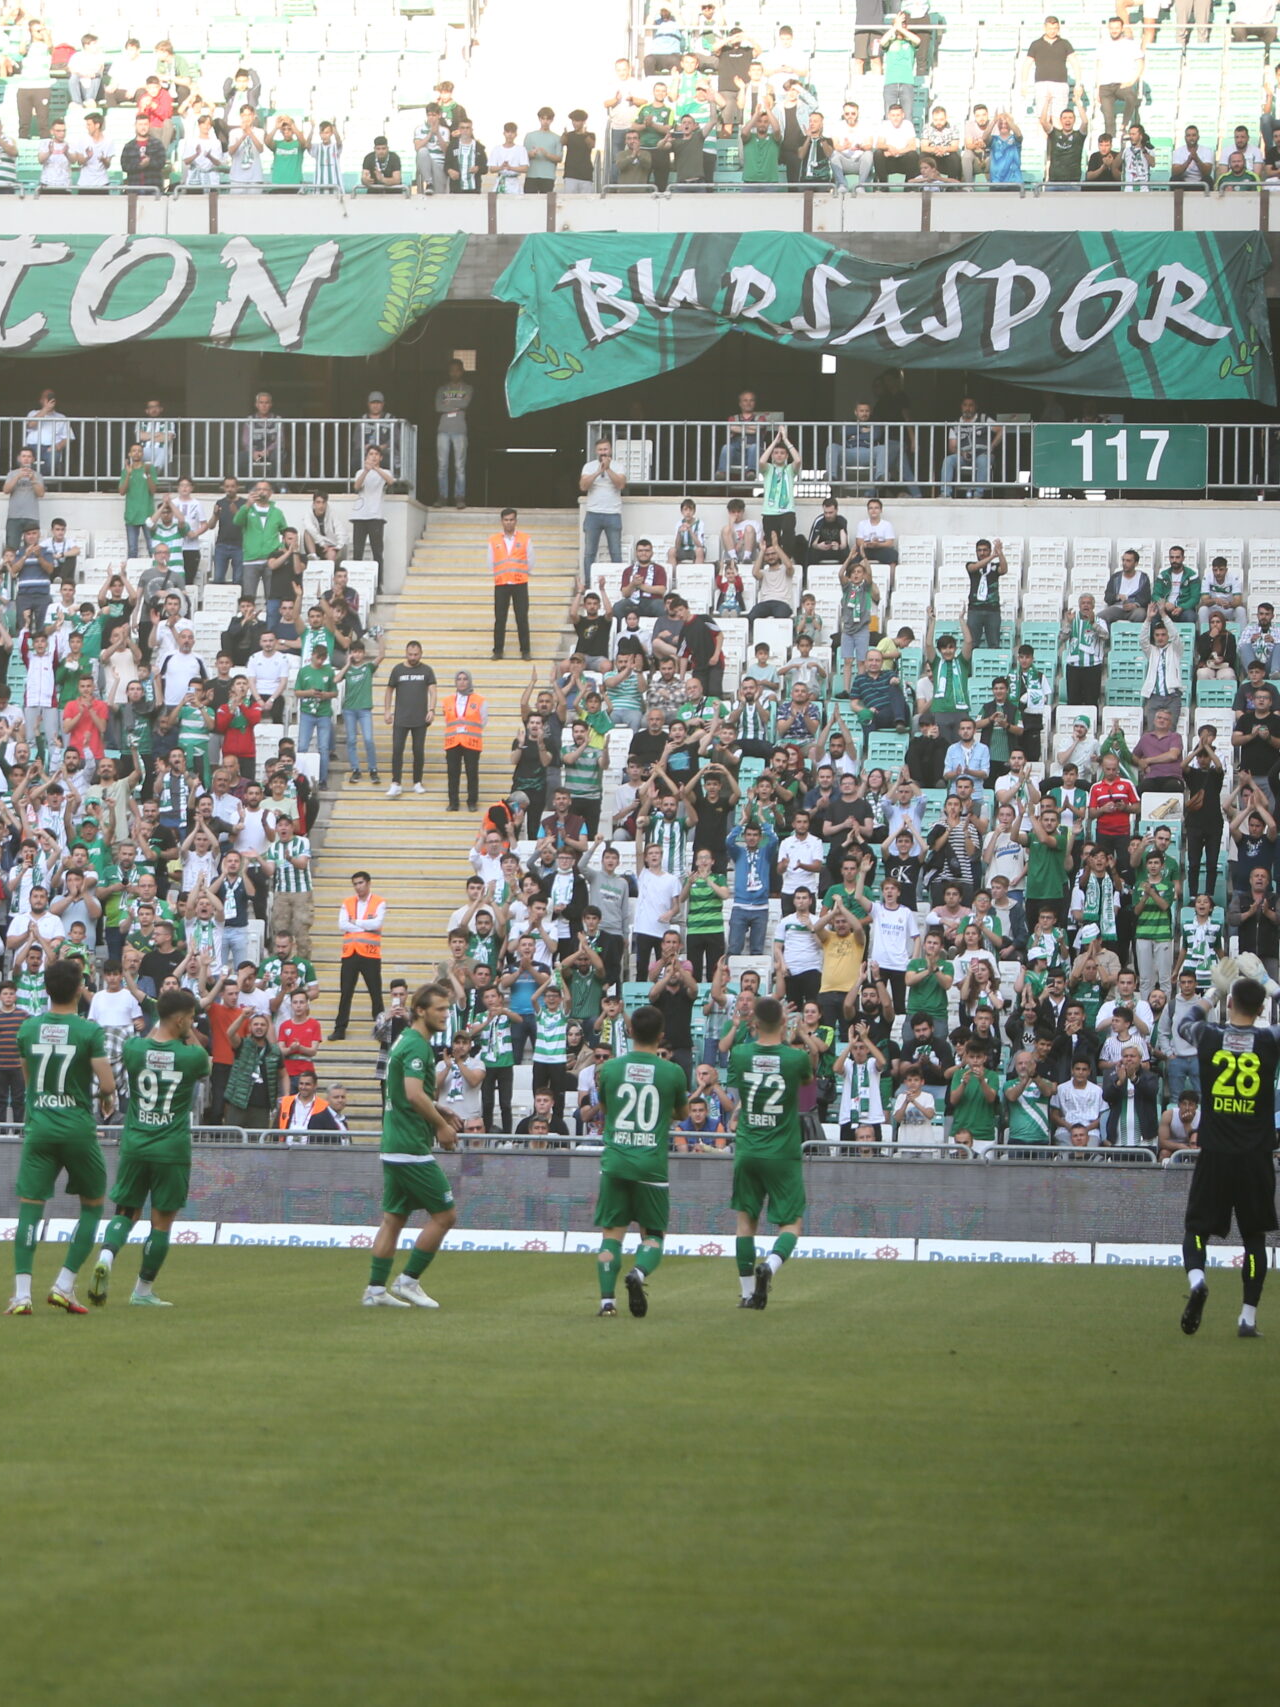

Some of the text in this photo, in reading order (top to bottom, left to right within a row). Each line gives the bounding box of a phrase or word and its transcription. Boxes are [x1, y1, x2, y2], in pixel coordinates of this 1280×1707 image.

[555, 256, 1232, 353] BURSASPOR
[1070, 429, 1171, 482] 117
[32, 1044, 77, 1093] 77
[1211, 1049, 1261, 1097] 28
[138, 1069, 183, 1113] 97
[615, 1083, 660, 1131] 20
[743, 1072, 786, 1114] 72
[138, 1110, 175, 1125] BERAT
[748, 1113, 776, 1126] EREN
[230, 1234, 342, 1248] DenizBank
[929, 1251, 1045, 1264] DenizBank
